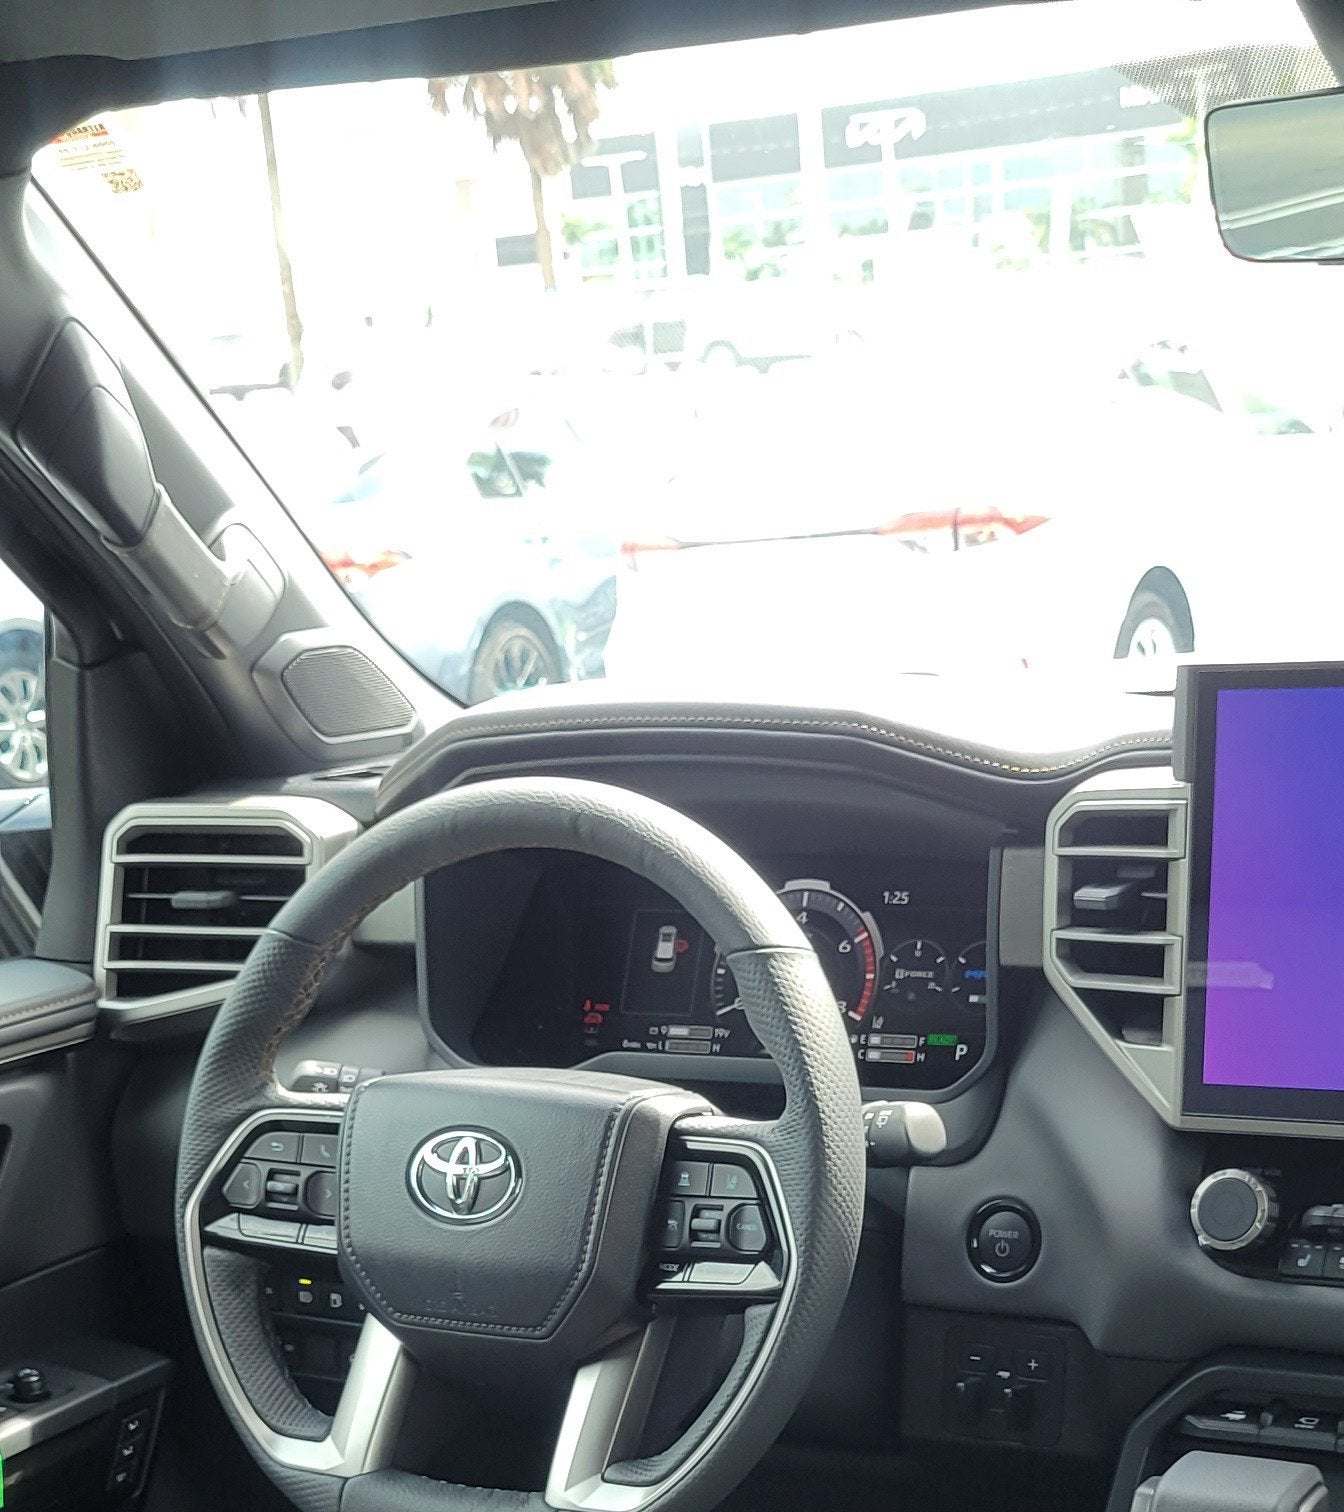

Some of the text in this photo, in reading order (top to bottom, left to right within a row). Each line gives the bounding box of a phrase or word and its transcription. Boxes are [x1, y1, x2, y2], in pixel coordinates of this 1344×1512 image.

[883, 891, 910, 905] 1:25
[838, 940, 851, 953] 6
[955, 1044, 968, 1061] P
[989, 1228, 1019, 1239] POWER
